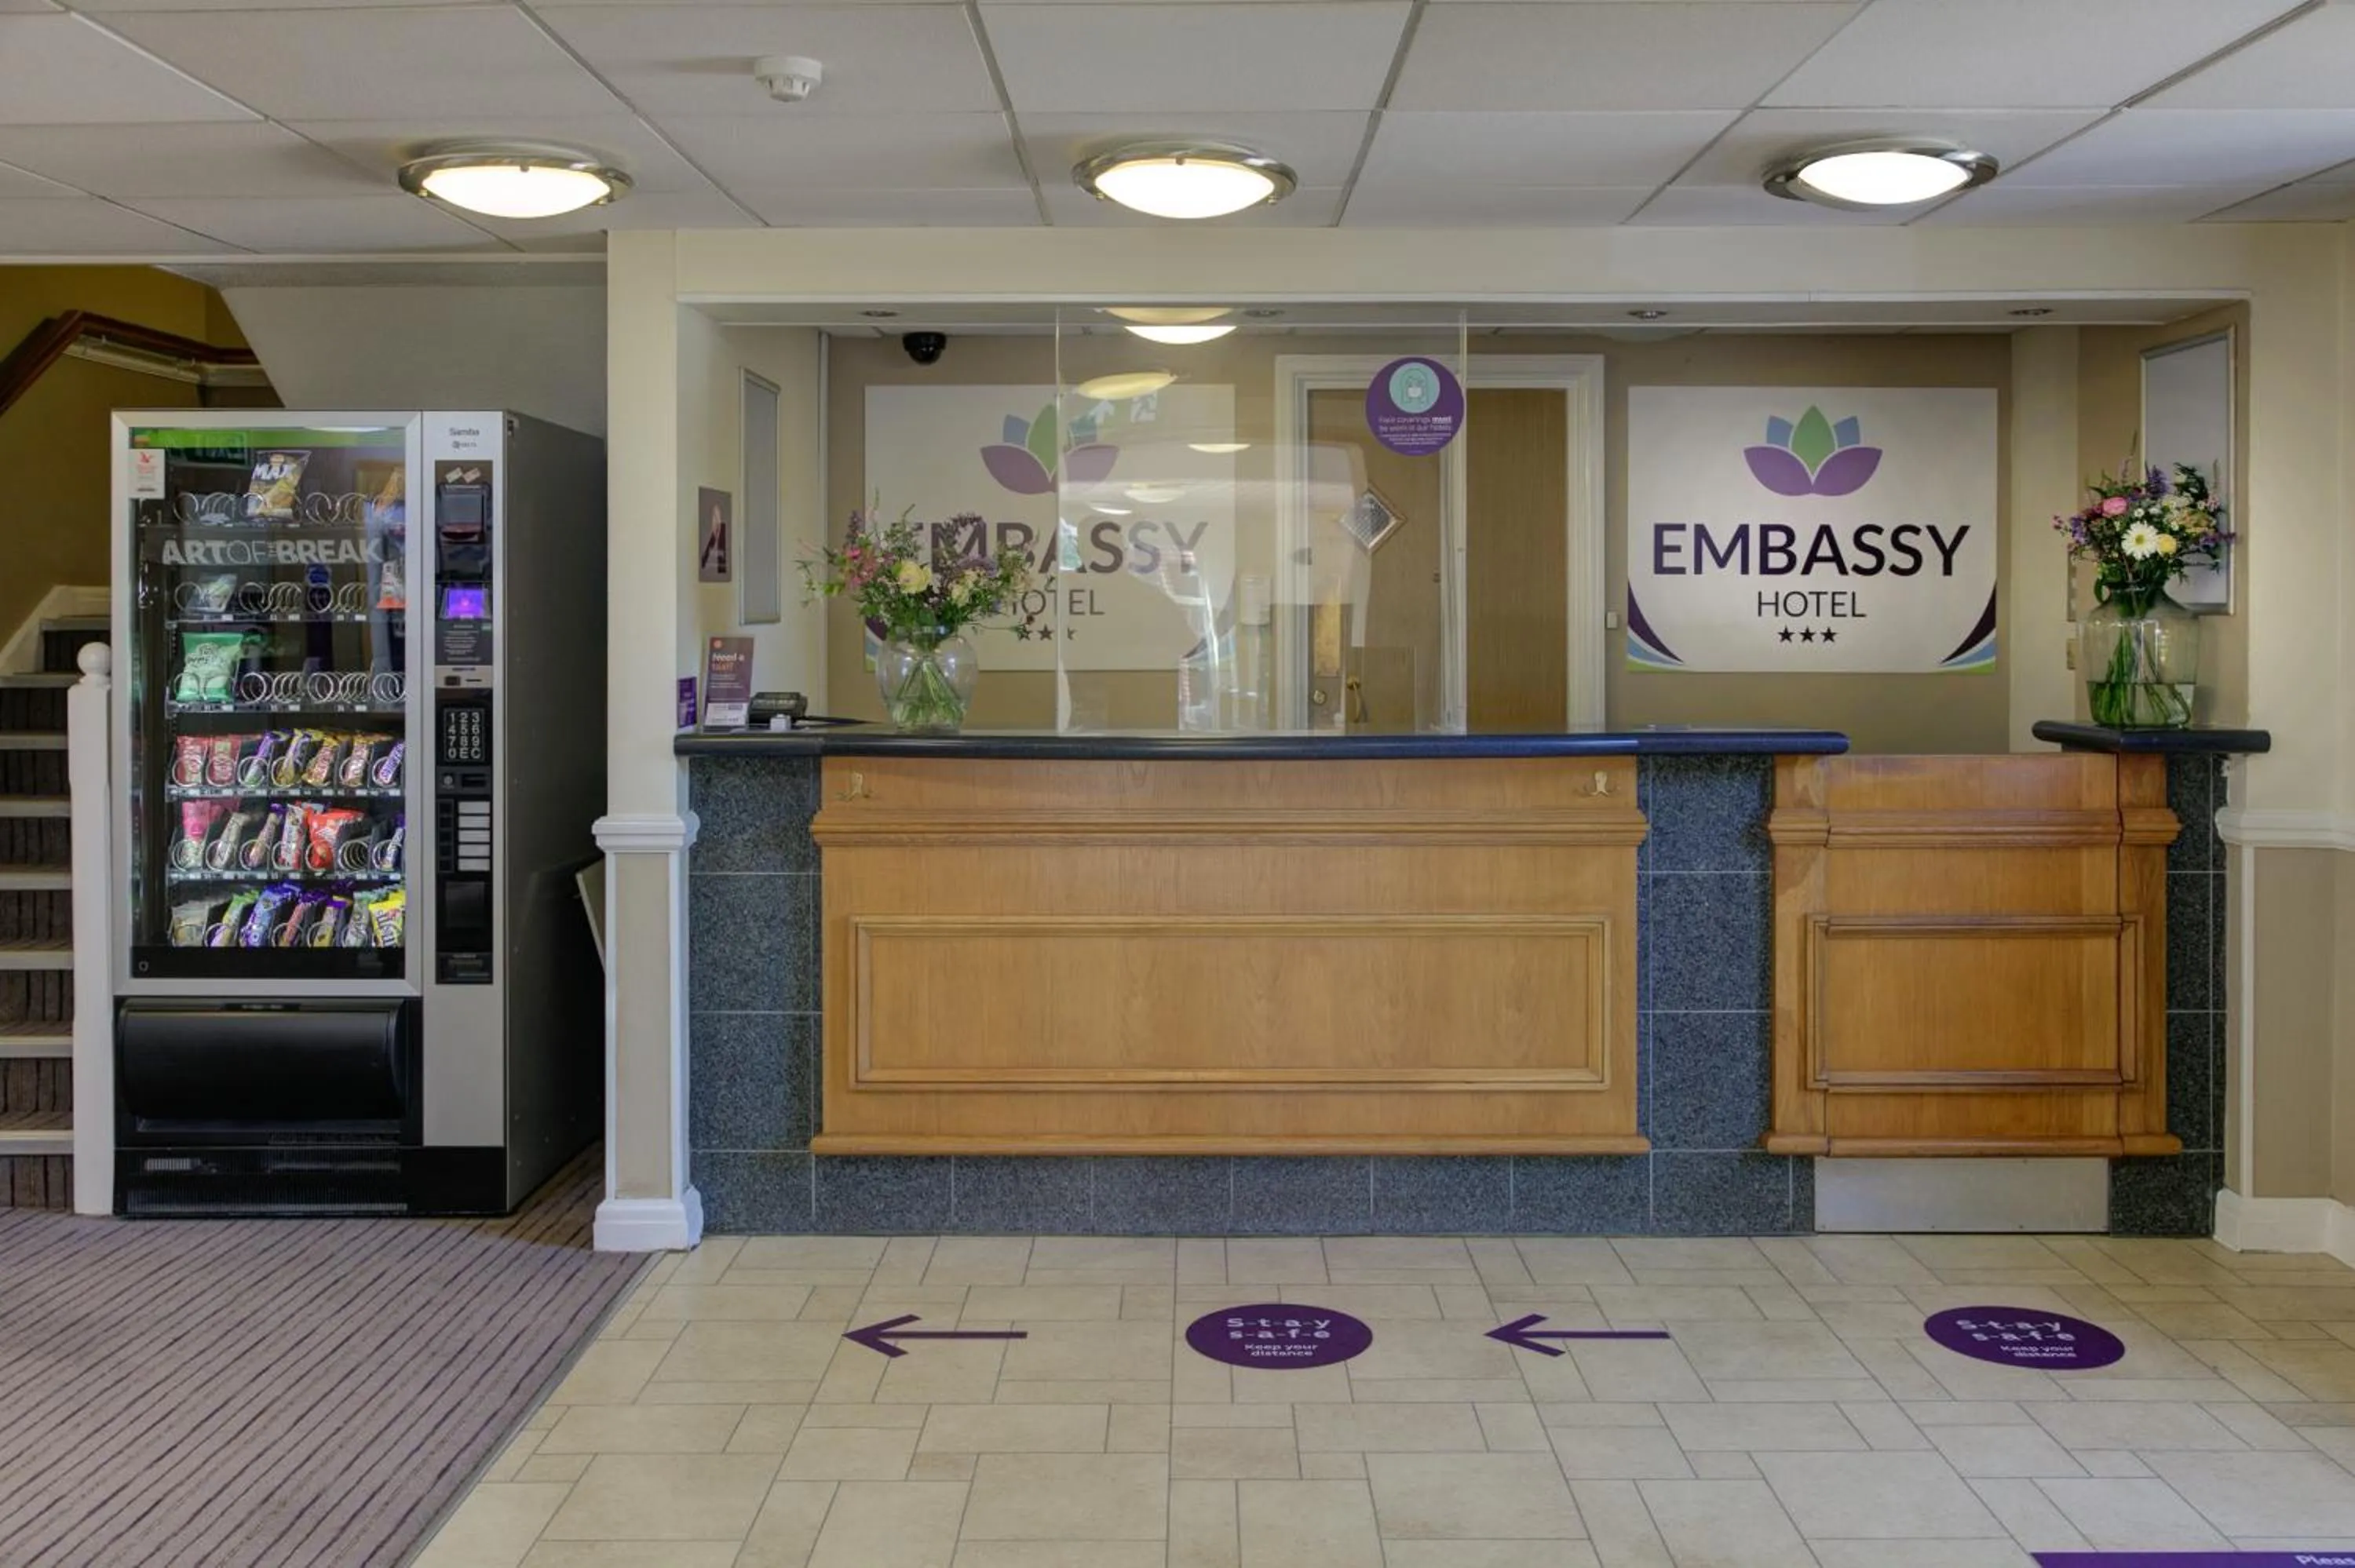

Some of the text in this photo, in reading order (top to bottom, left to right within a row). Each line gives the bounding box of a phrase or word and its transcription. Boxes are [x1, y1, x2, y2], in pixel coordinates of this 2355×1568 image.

[277, 538, 385, 565] BREAK
[1652, 523, 1972, 576] EMBASSY
[1757, 591, 1867, 618] HOTEL
